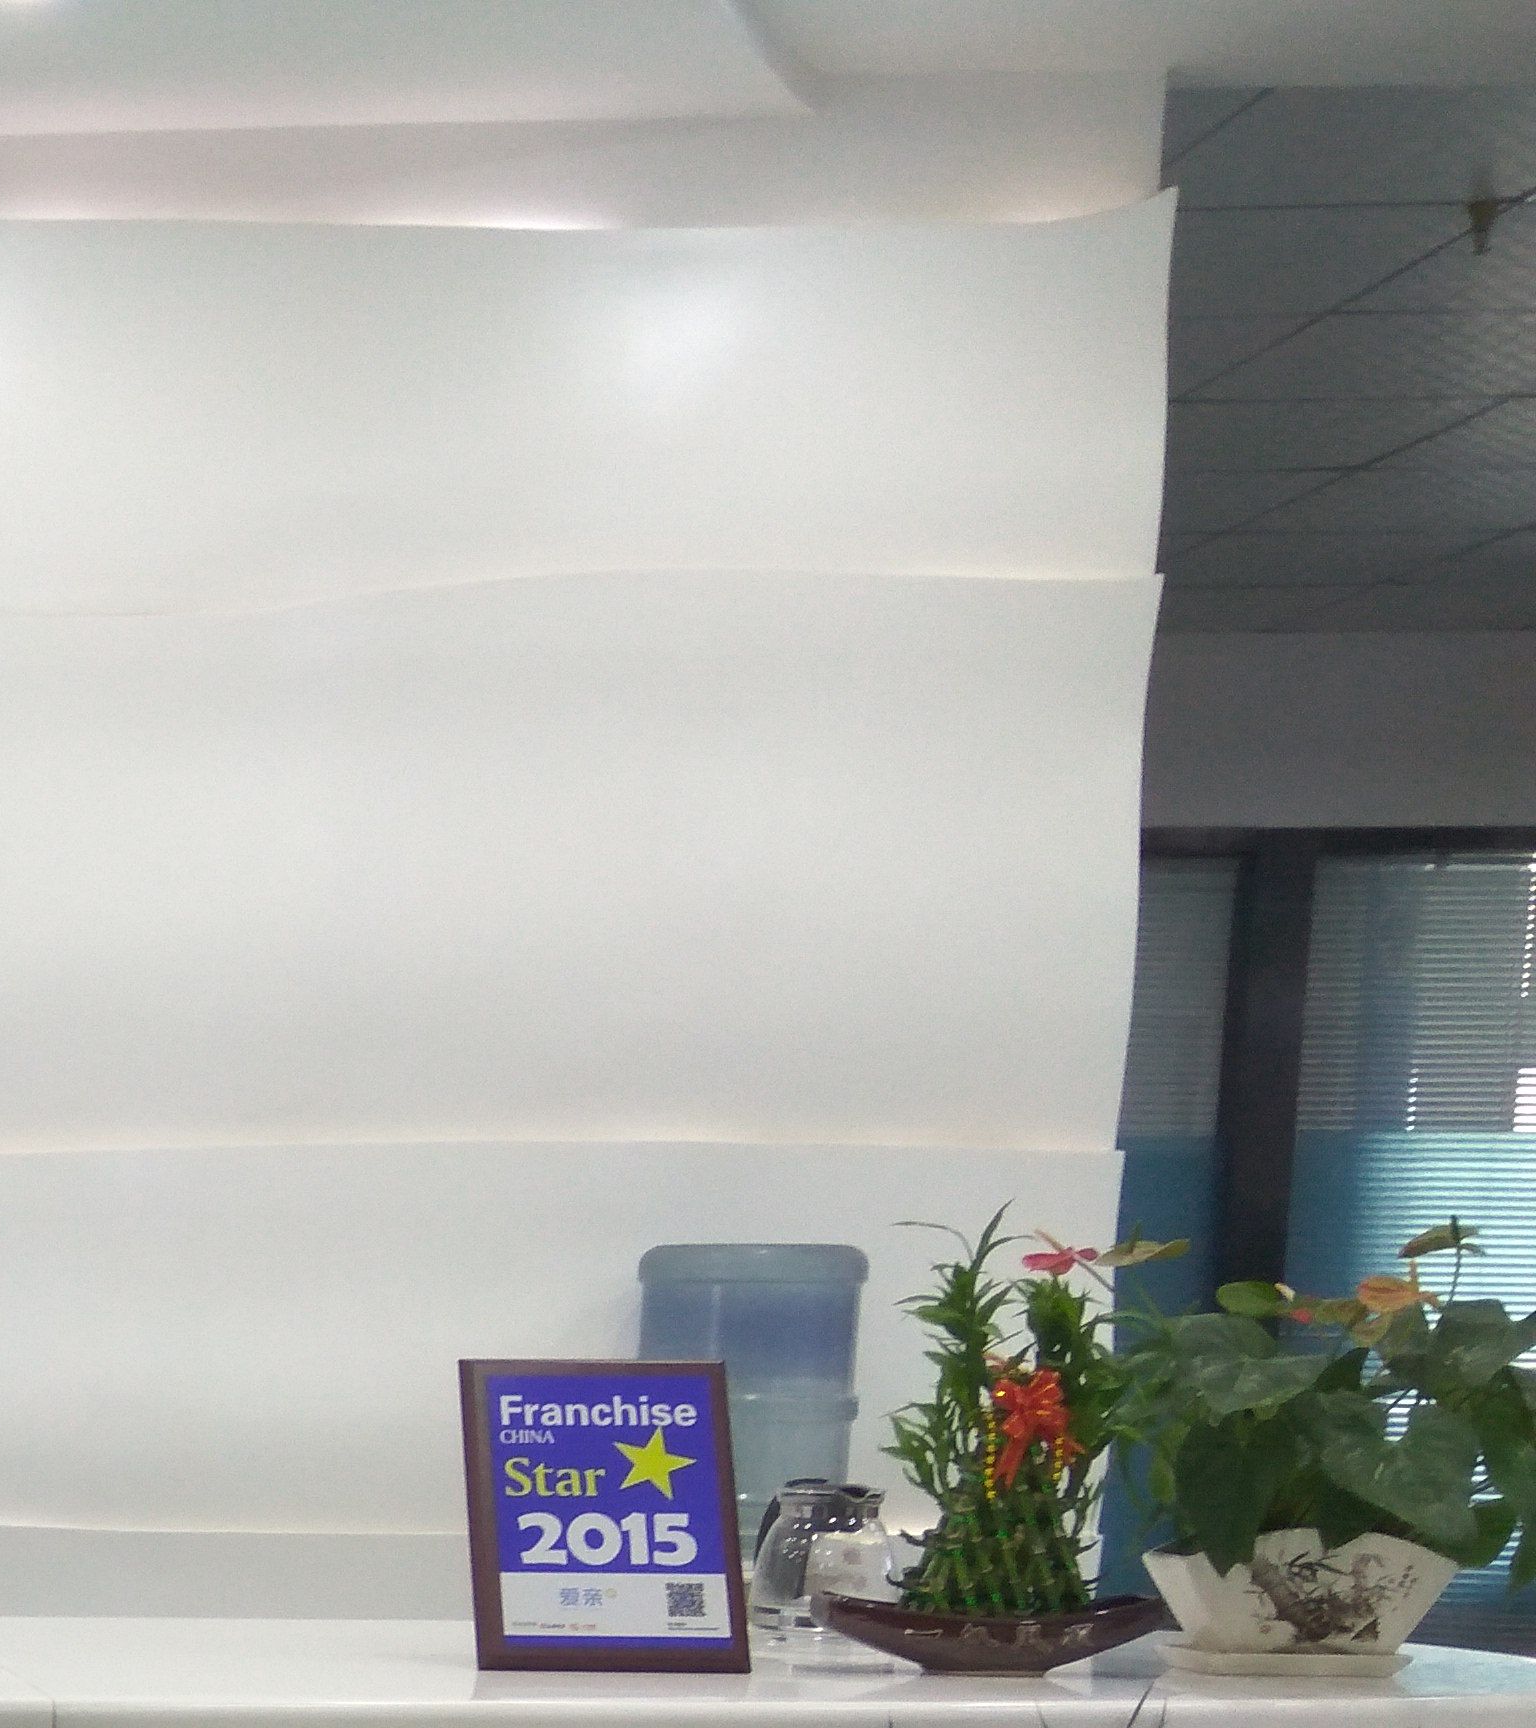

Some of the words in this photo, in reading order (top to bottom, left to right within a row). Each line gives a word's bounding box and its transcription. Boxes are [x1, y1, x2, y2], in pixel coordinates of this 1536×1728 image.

[499, 1395, 697, 1427] Franchise
[499, 1430, 555, 1444] CHINA
[504, 1457, 606, 1497] Star
[517, 1512, 698, 1566] 2015
